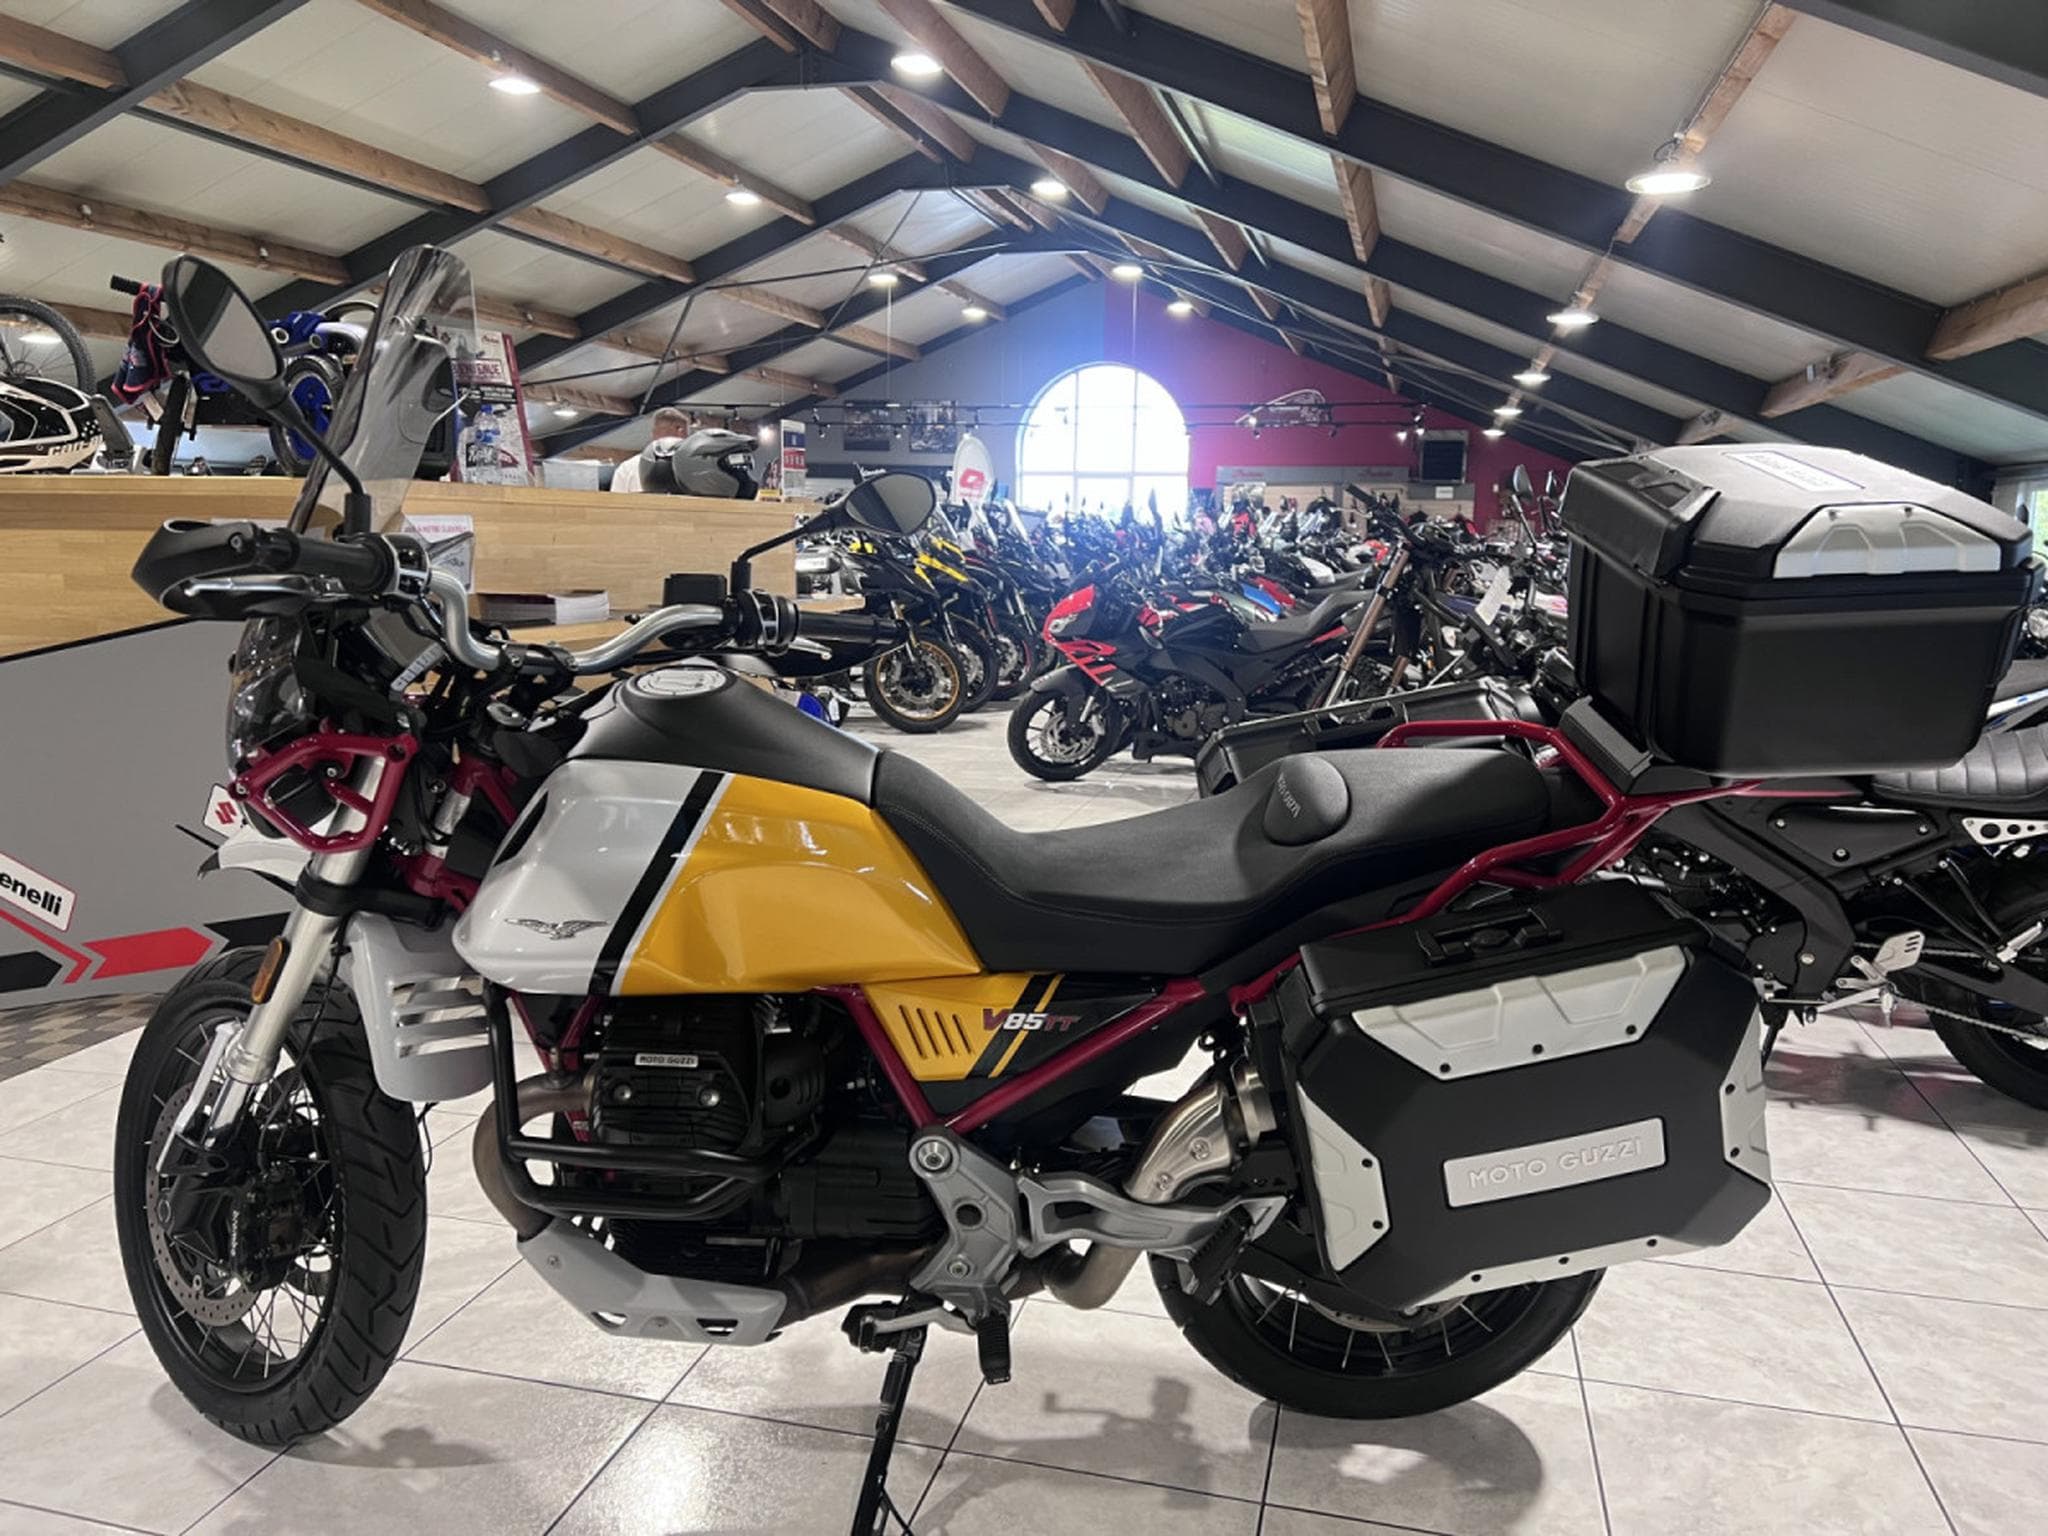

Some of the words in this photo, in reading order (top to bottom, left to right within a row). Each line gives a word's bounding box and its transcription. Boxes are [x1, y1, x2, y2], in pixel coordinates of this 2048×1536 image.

[640, 1056, 665, 1064] MOTO
[1469, 1159, 1548, 1188] MOTO
[1558, 1136, 1642, 1171] GUZZI
